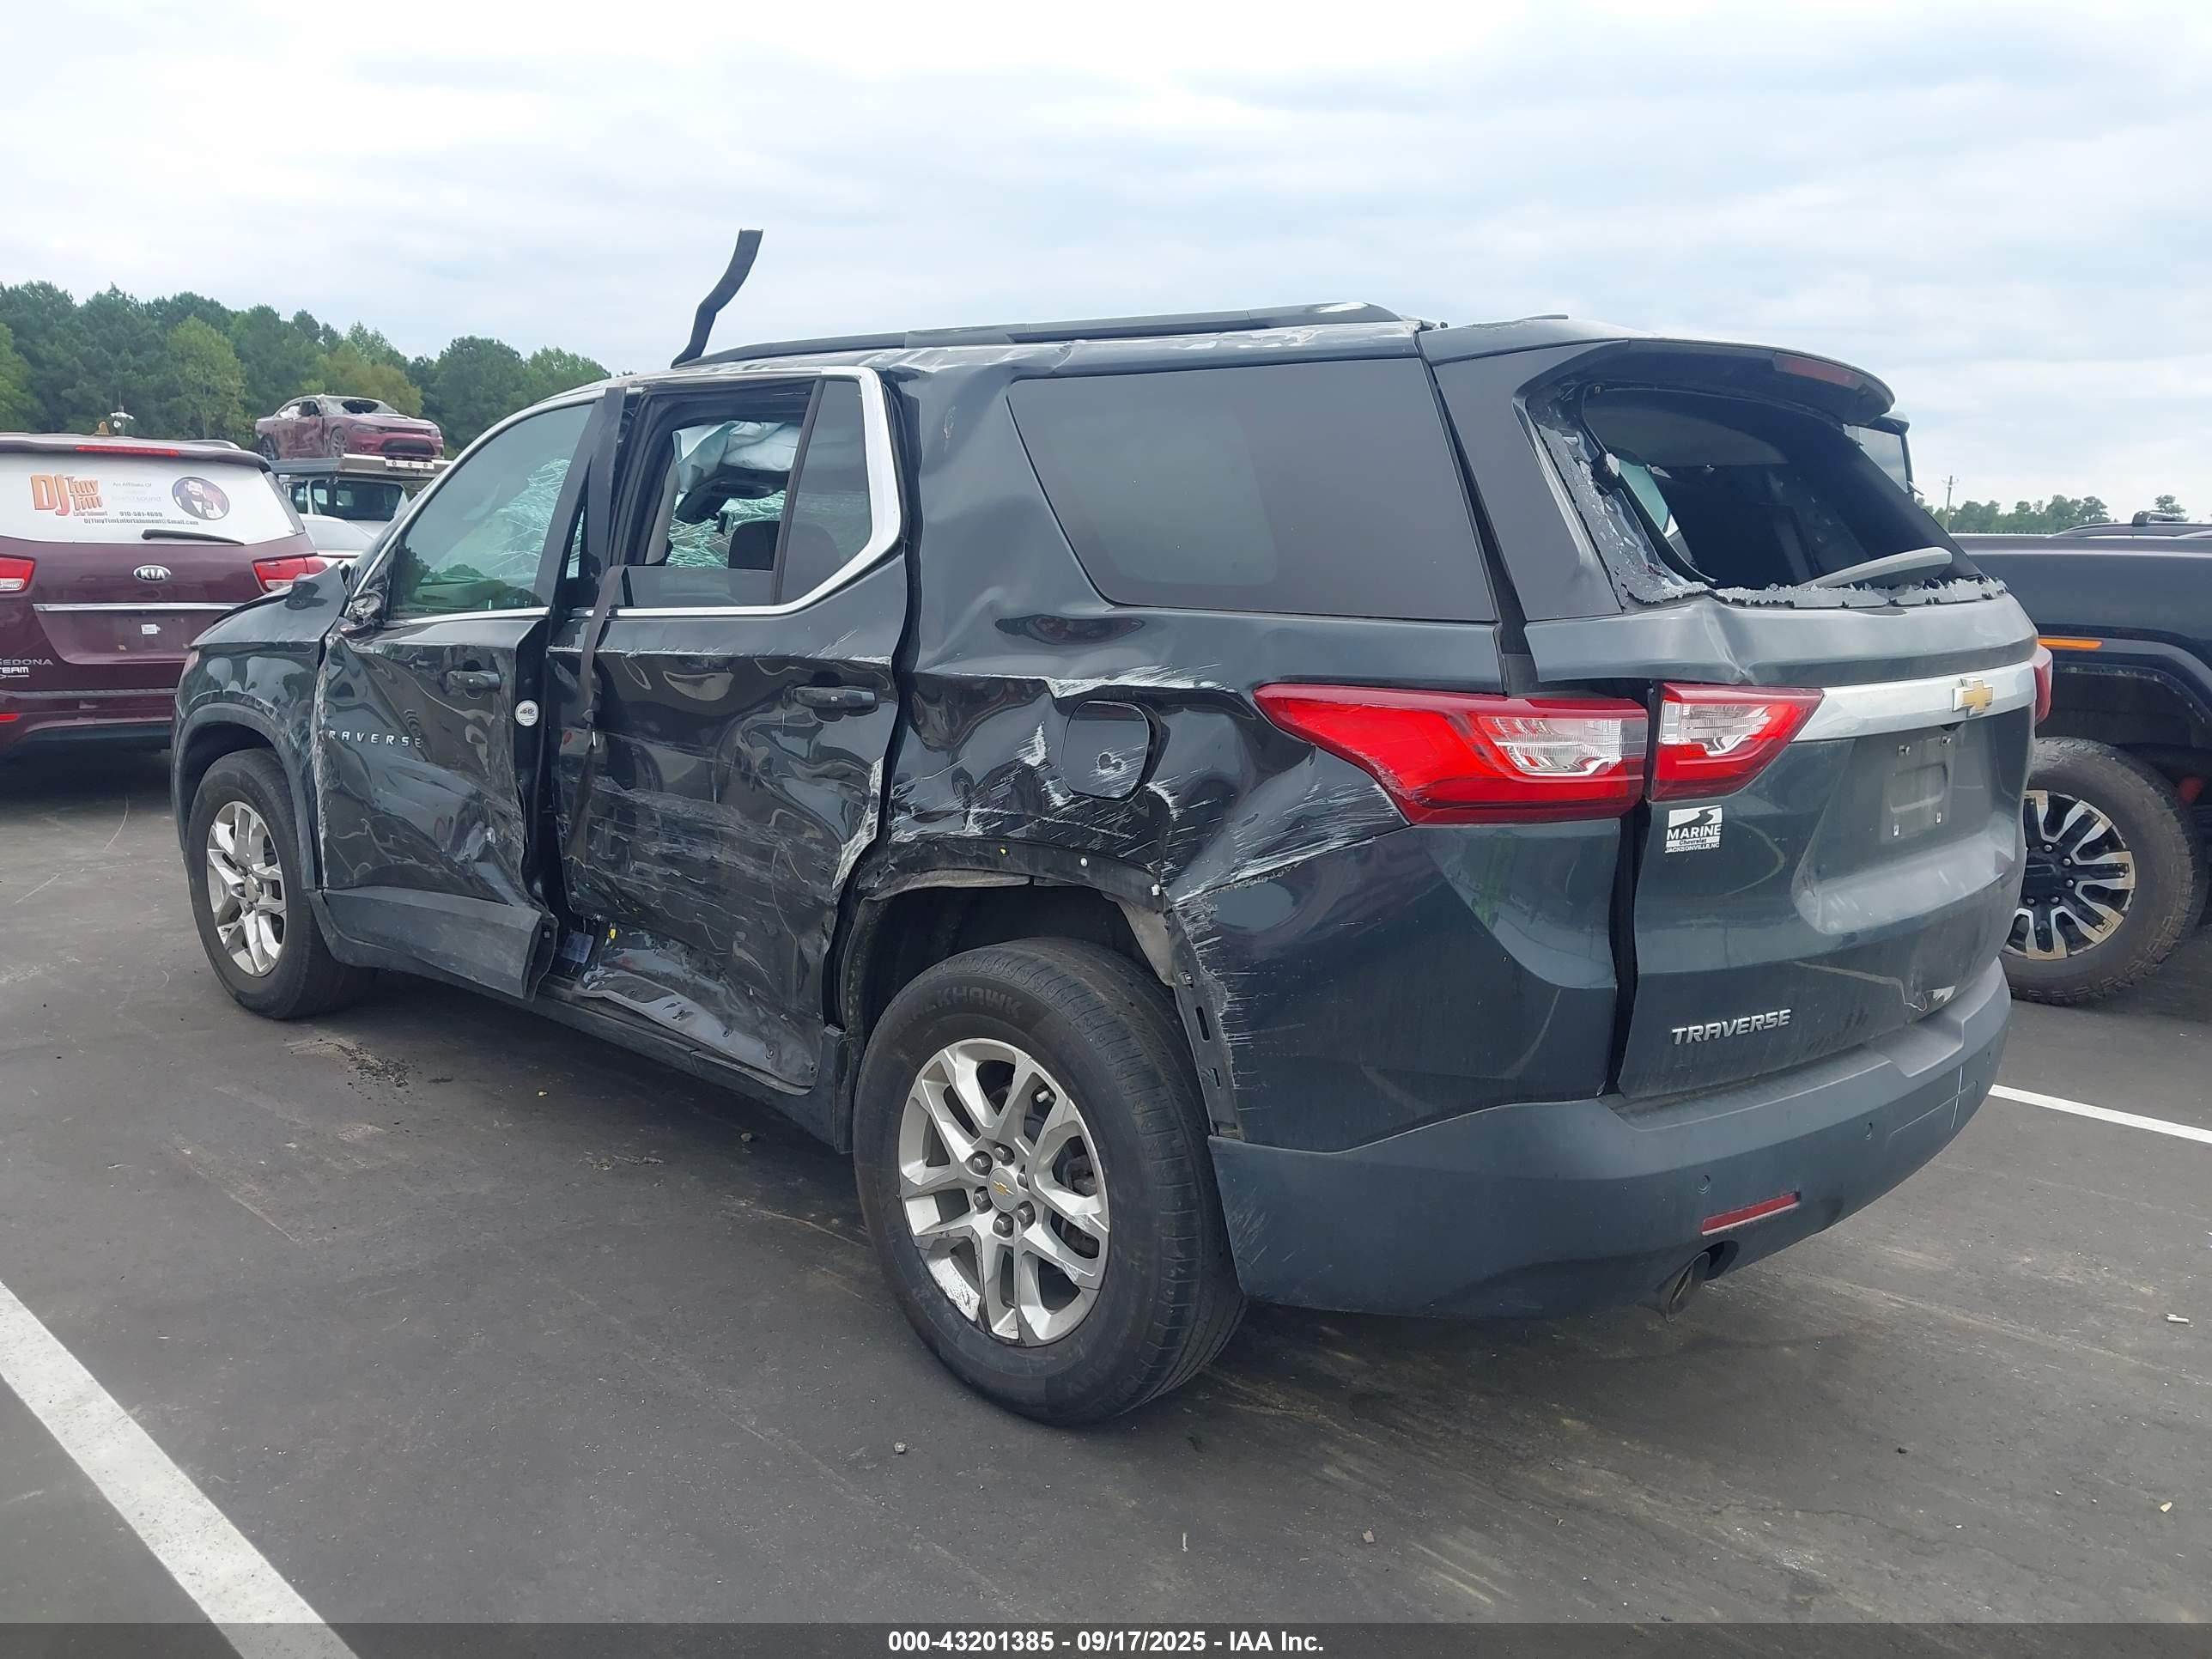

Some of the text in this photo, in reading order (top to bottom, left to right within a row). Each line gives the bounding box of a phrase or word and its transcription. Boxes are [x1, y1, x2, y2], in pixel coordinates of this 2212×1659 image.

[65, 476, 99, 496] Tiny
[70, 494, 104, 512] Tim
[140, 568, 165, 580] KIA
[1666, 823, 1723, 841] MARINE
[1671, 1008, 1792, 1045] TRAVERSE
